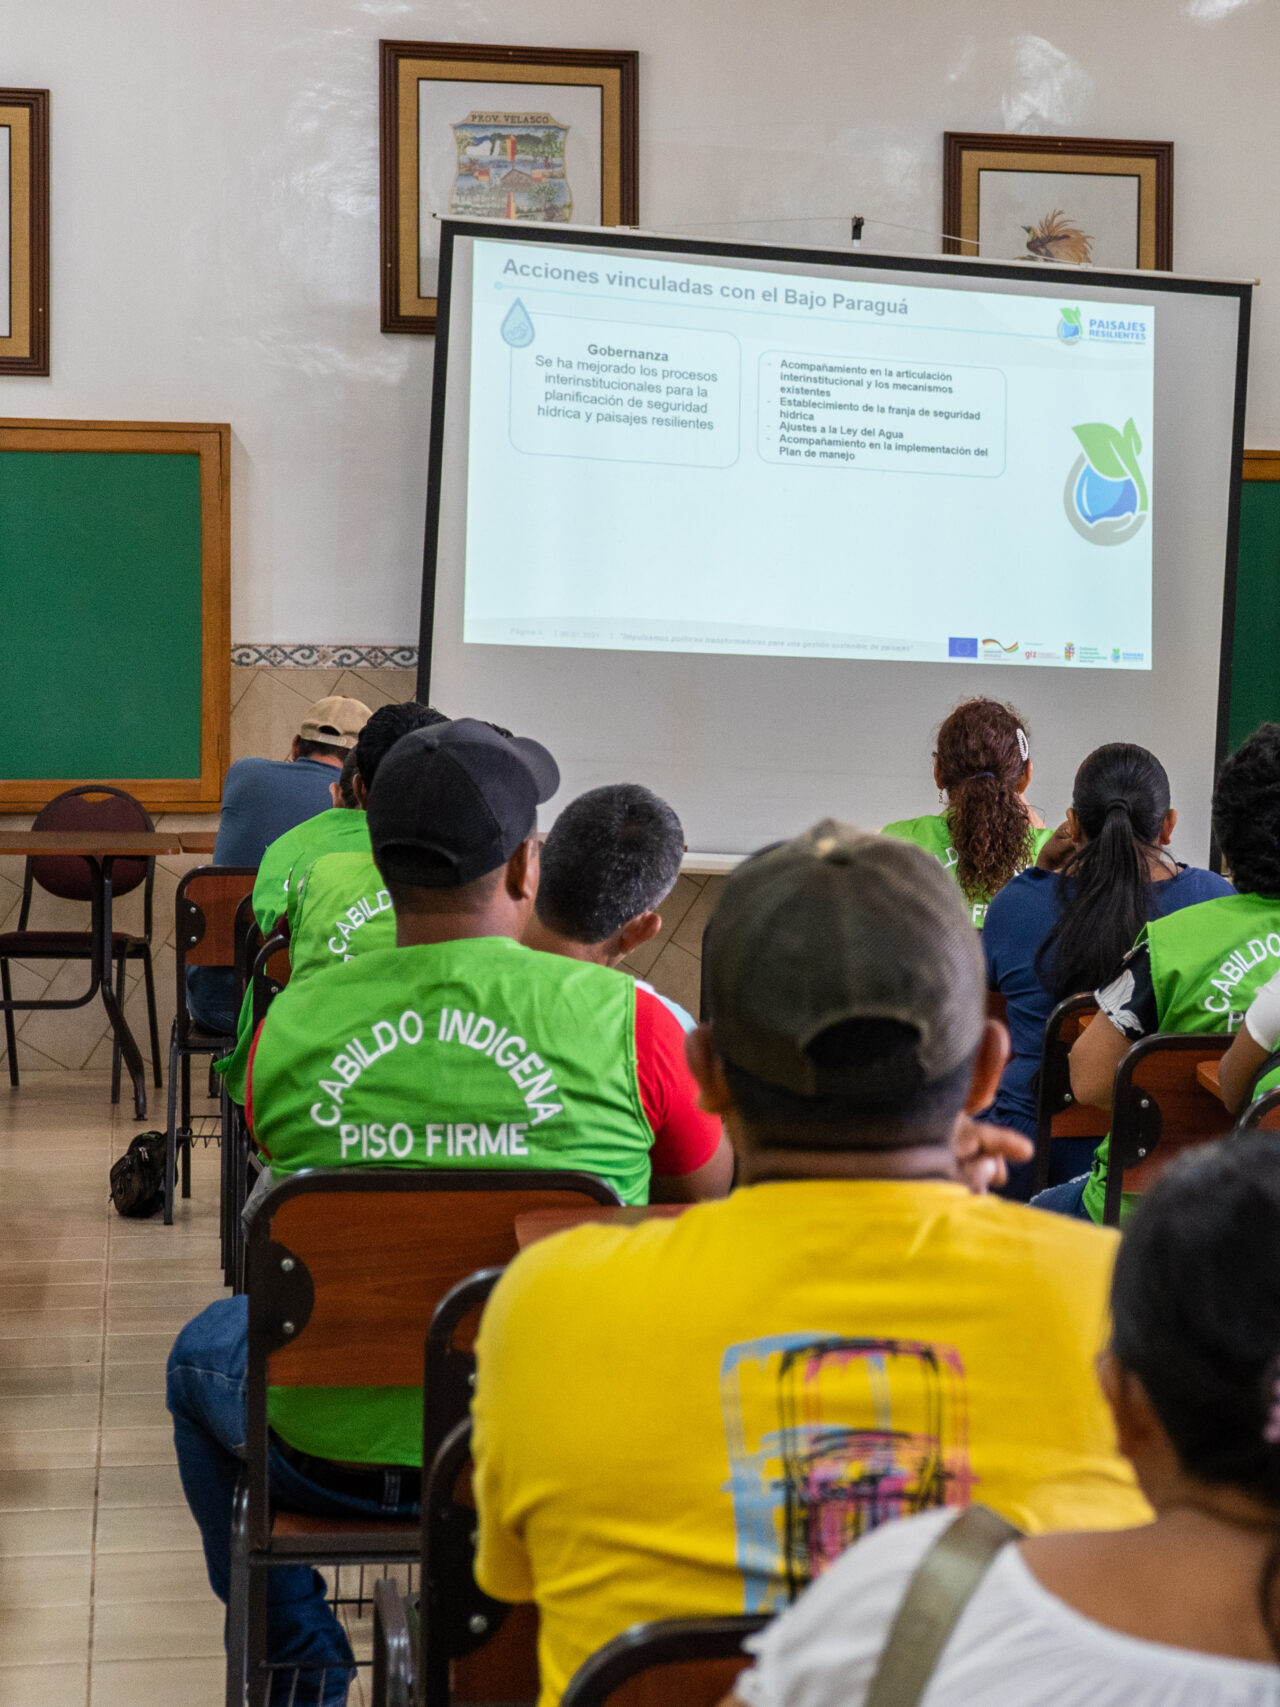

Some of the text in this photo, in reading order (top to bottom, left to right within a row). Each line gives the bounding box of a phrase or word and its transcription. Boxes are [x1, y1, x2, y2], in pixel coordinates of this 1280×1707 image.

[503, 115, 549, 124] VELASCO
[503, 258, 909, 316] Acciones vinculadas con el Bajo Paraguá
[1089, 319, 1146, 332] PAISAJES
[1089, 329, 1146, 341] RESILIENTES
[587, 344, 669, 362] Gobernanza
[535, 355, 718, 382] Se ha mejorado los procesos
[780, 360, 952, 382] Acompañamiento en la articulación
[545, 373, 708, 398] interinstitucionales para la
[780, 372, 953, 394] interinstitucional y los mecanismos
[780, 386, 831, 397] existentes
[544, 390, 708, 415] planificación de seguridad
[780, 397, 981, 421] Establecimiento de la franja de seguridad
[585, 411, 592, 423] y
[596, 411, 648, 426] paisajes
[652, 415, 714, 430] resilientes
[779, 421, 817, 433] Ajustes
[828, 425, 838, 434] la
[840, 425, 858, 437] Ley
[860, 427, 876, 437] del
[878, 429, 904, 440] Agua
[779, 434, 988, 457] Acompañamiento en la implementación del
[779, 446, 855, 461] Plan de manejo
[328, 889, 394, 954] CABILD
[310, 1007, 564, 1127] CABILDO INDIGENA
[340, 1122, 530, 1159] PISO FIRME
